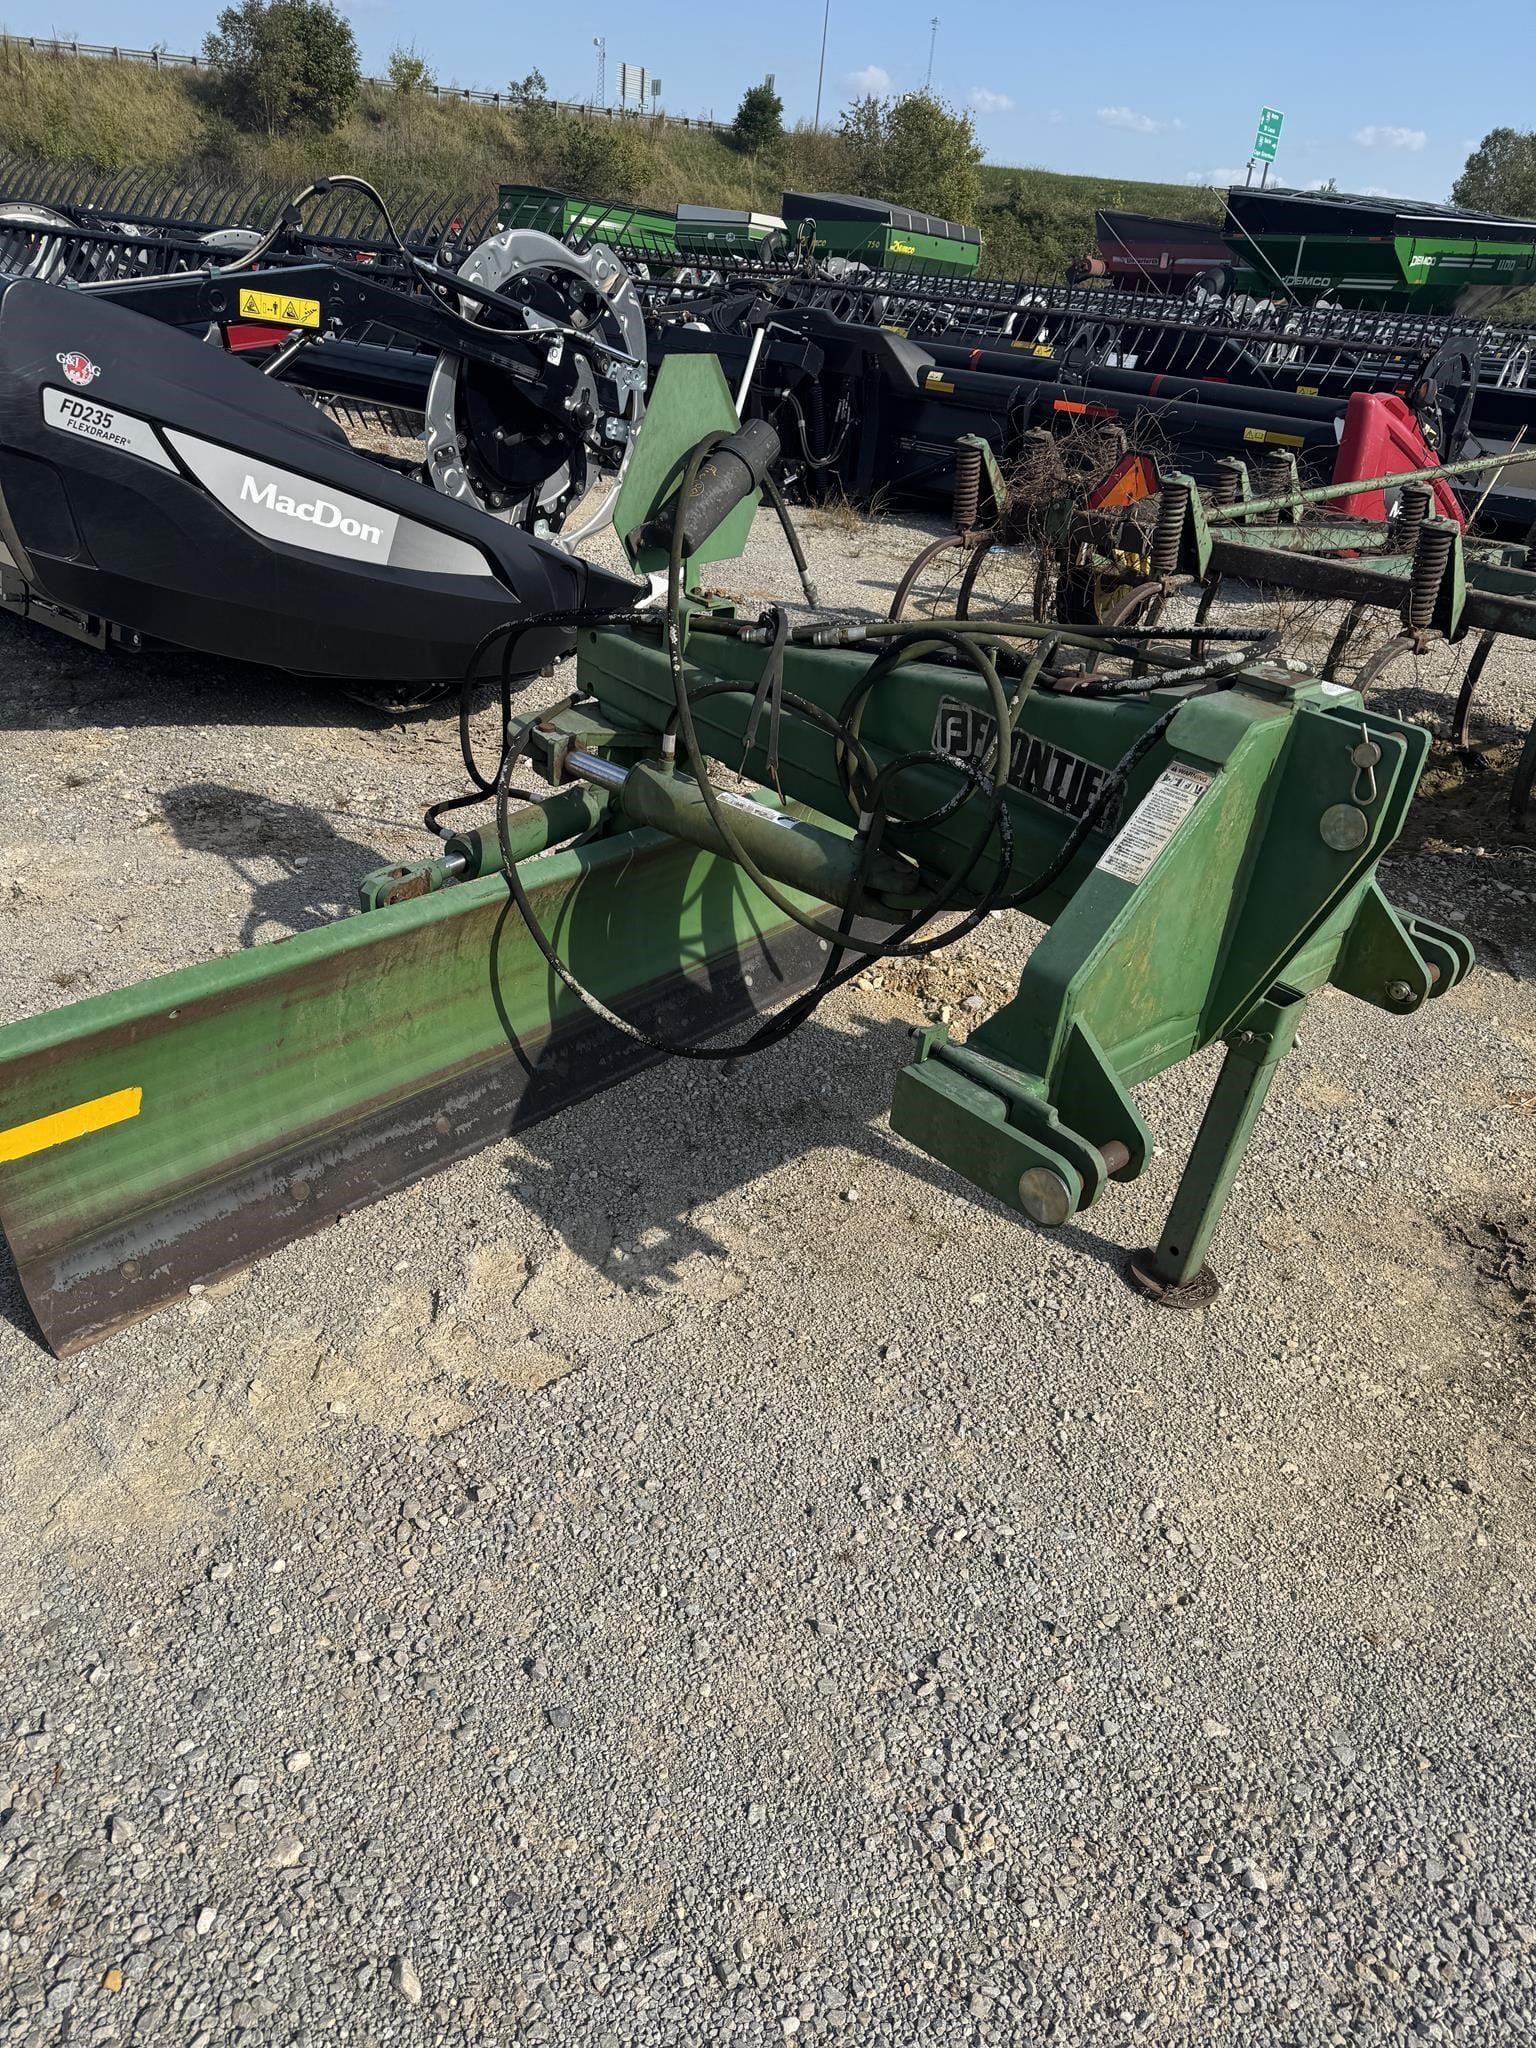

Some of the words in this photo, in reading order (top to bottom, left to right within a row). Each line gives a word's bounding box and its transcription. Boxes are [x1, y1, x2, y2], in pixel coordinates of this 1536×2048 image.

[867, 240, 880, 249] 750
[1285, 276, 1331, 287] DEMCO
[56, 352, 80, 369] G&J
[59, 398, 114, 429] FD235
[240, 474, 381, 545] MacDon
